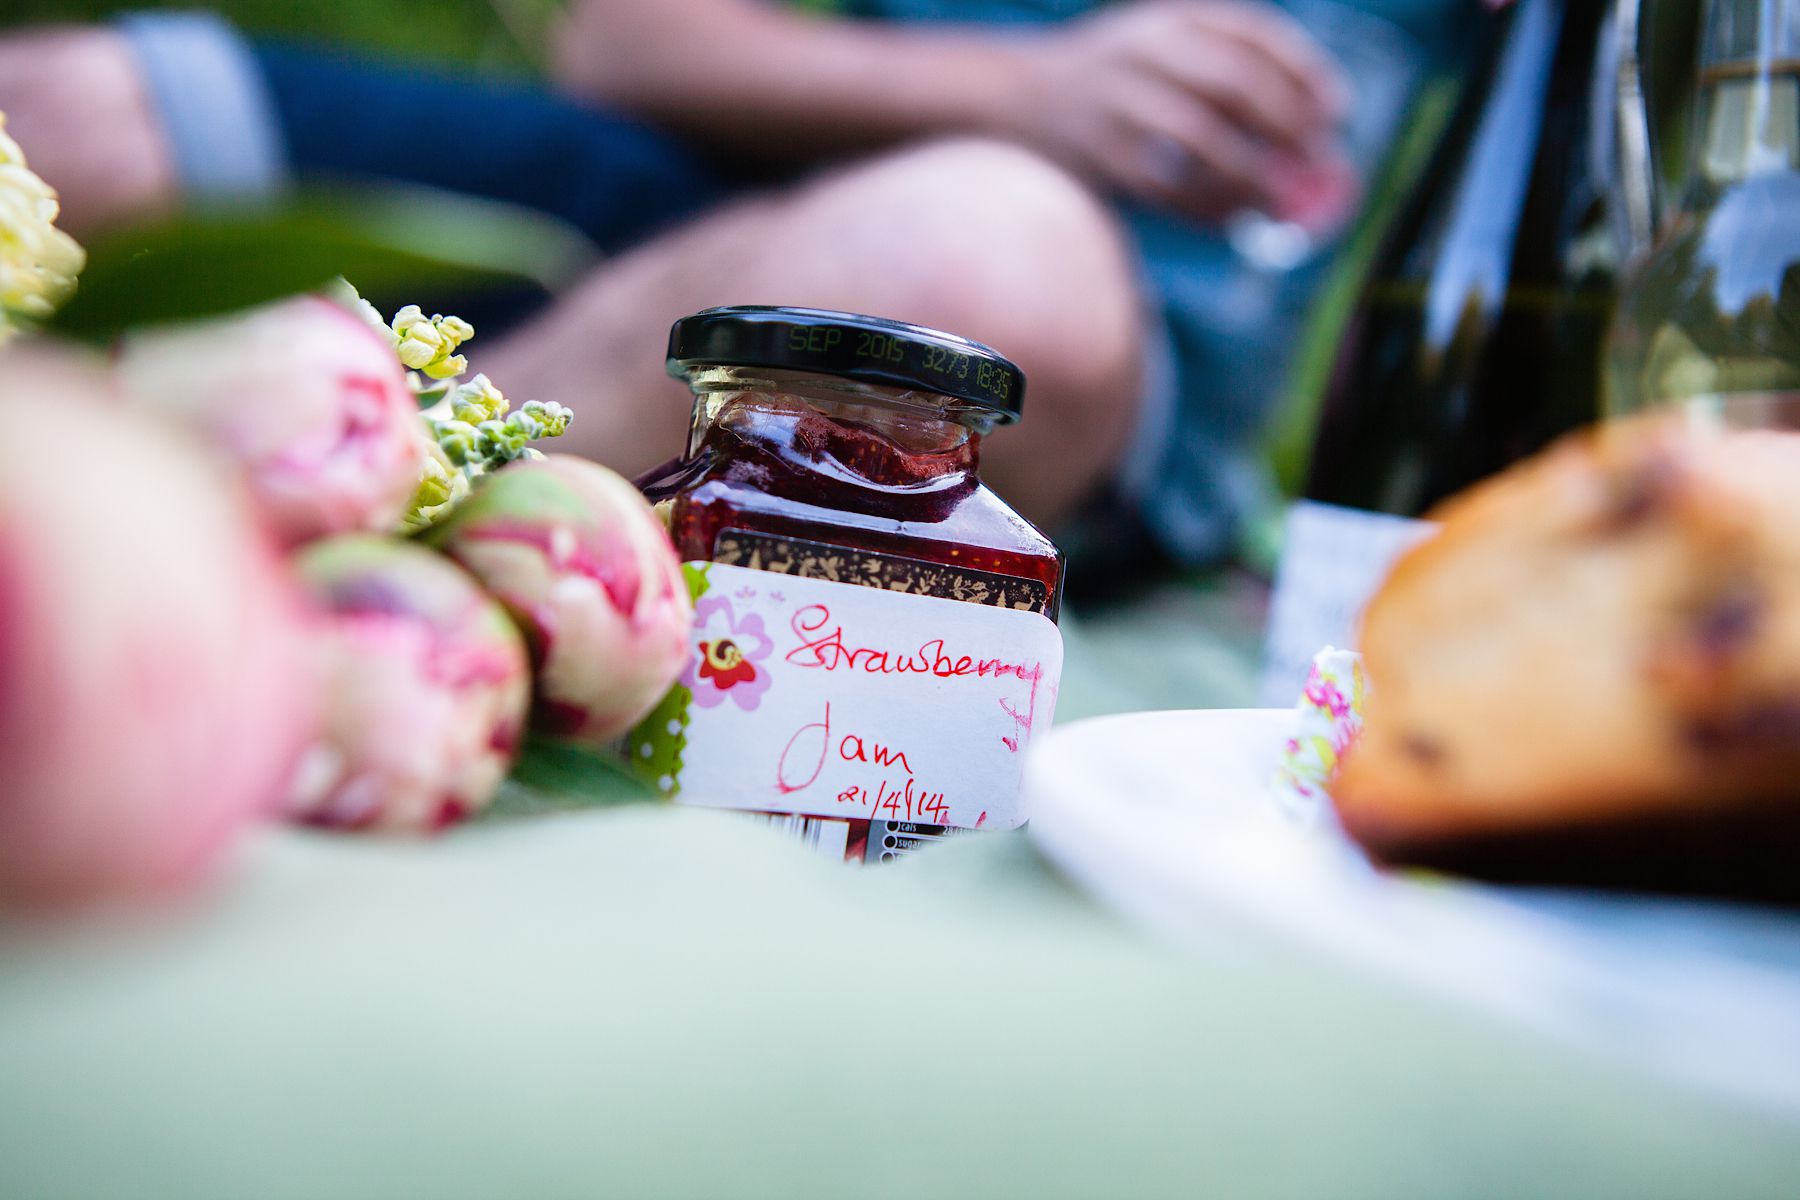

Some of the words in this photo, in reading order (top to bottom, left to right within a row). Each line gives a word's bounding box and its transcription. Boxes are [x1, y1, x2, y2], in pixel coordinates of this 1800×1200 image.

[788, 326, 842, 352] SEP
[856, 333, 904, 362] 2015
[922, 345, 970, 379] 3273
[977, 359, 1012, 400] 18:35
[785, 604, 1042, 742] Strawberry
[778, 701, 913, 794] Jam
[837, 778, 949, 821] 21/4/14
[901, 822, 917, 833] cals
